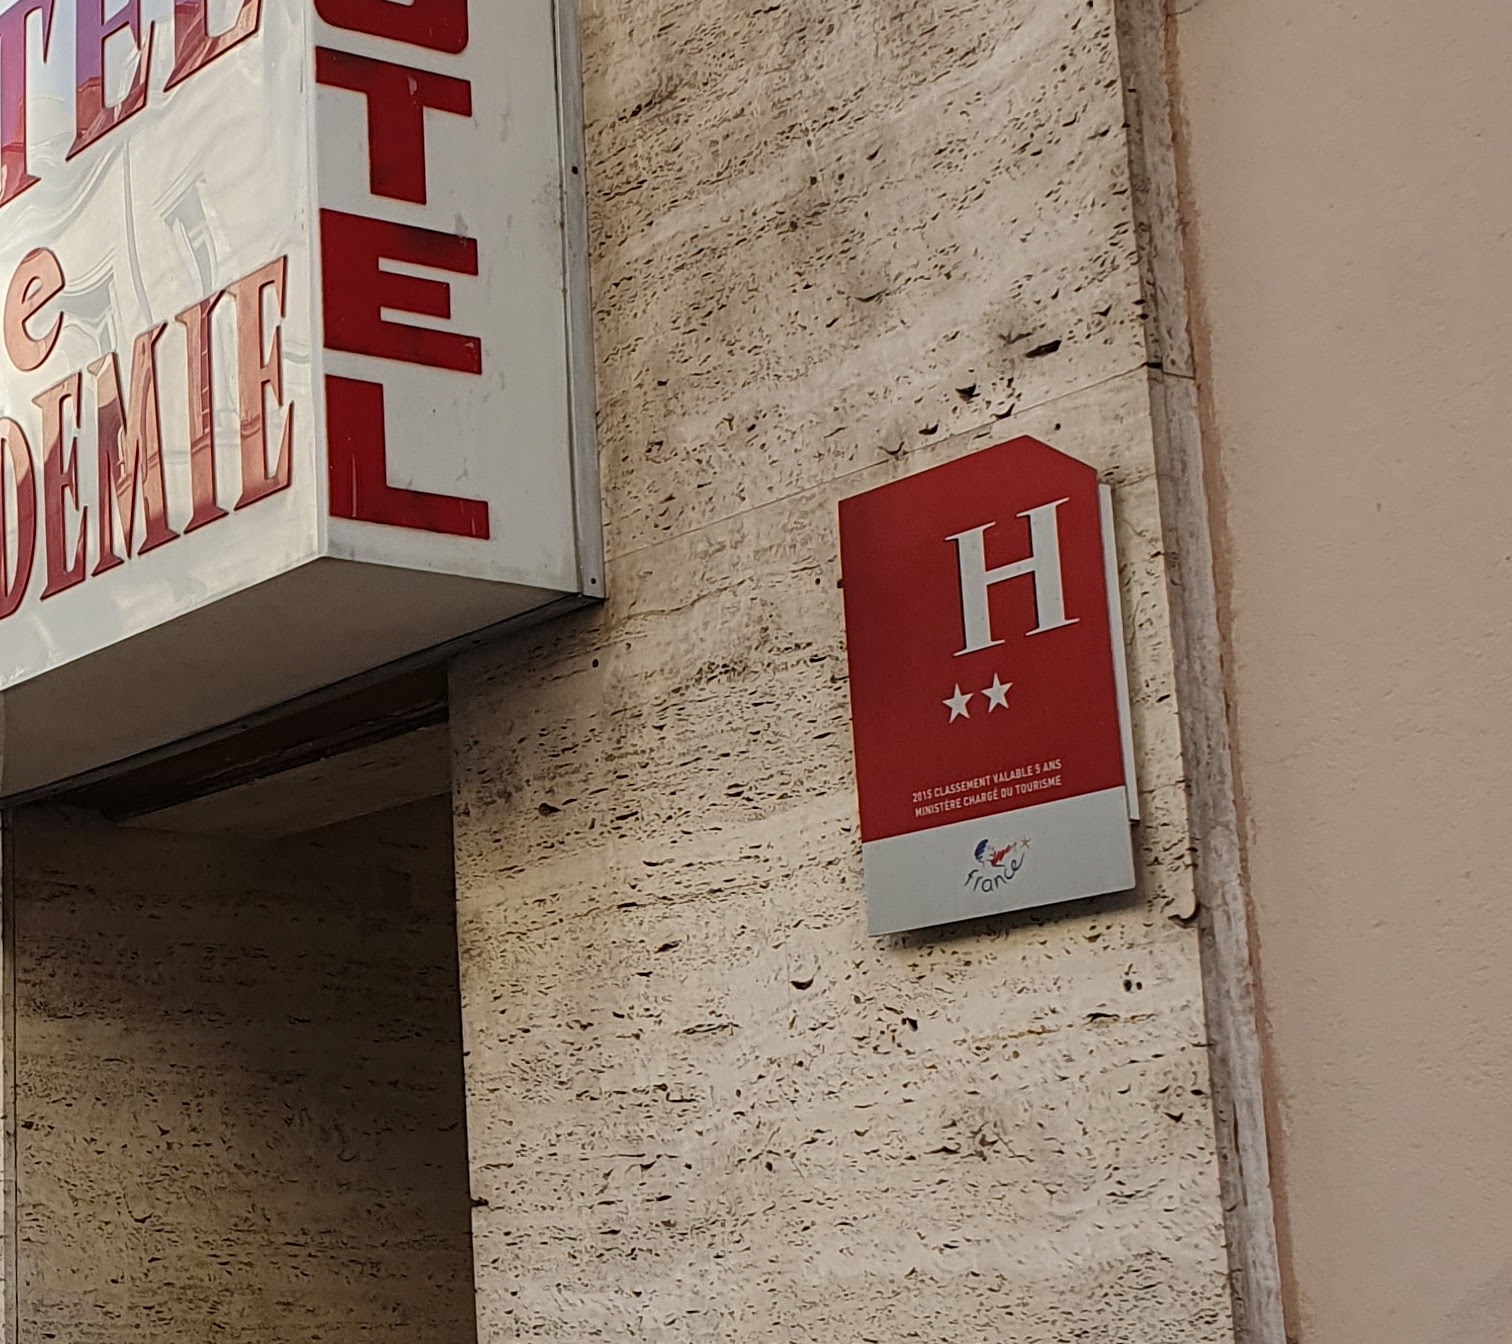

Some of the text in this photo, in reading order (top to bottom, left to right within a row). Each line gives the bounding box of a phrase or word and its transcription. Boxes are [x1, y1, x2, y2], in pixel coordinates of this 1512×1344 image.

[944, 497, 1080, 657] H
[912, 759, 1062, 803] 2015 CLASSEMENT VALABLE 5 ANS
[963, 786, 999, 807] CHARGÉ
[1000, 788, 1013, 799] DU
[1014, 775, 1062, 794] TOURISME
